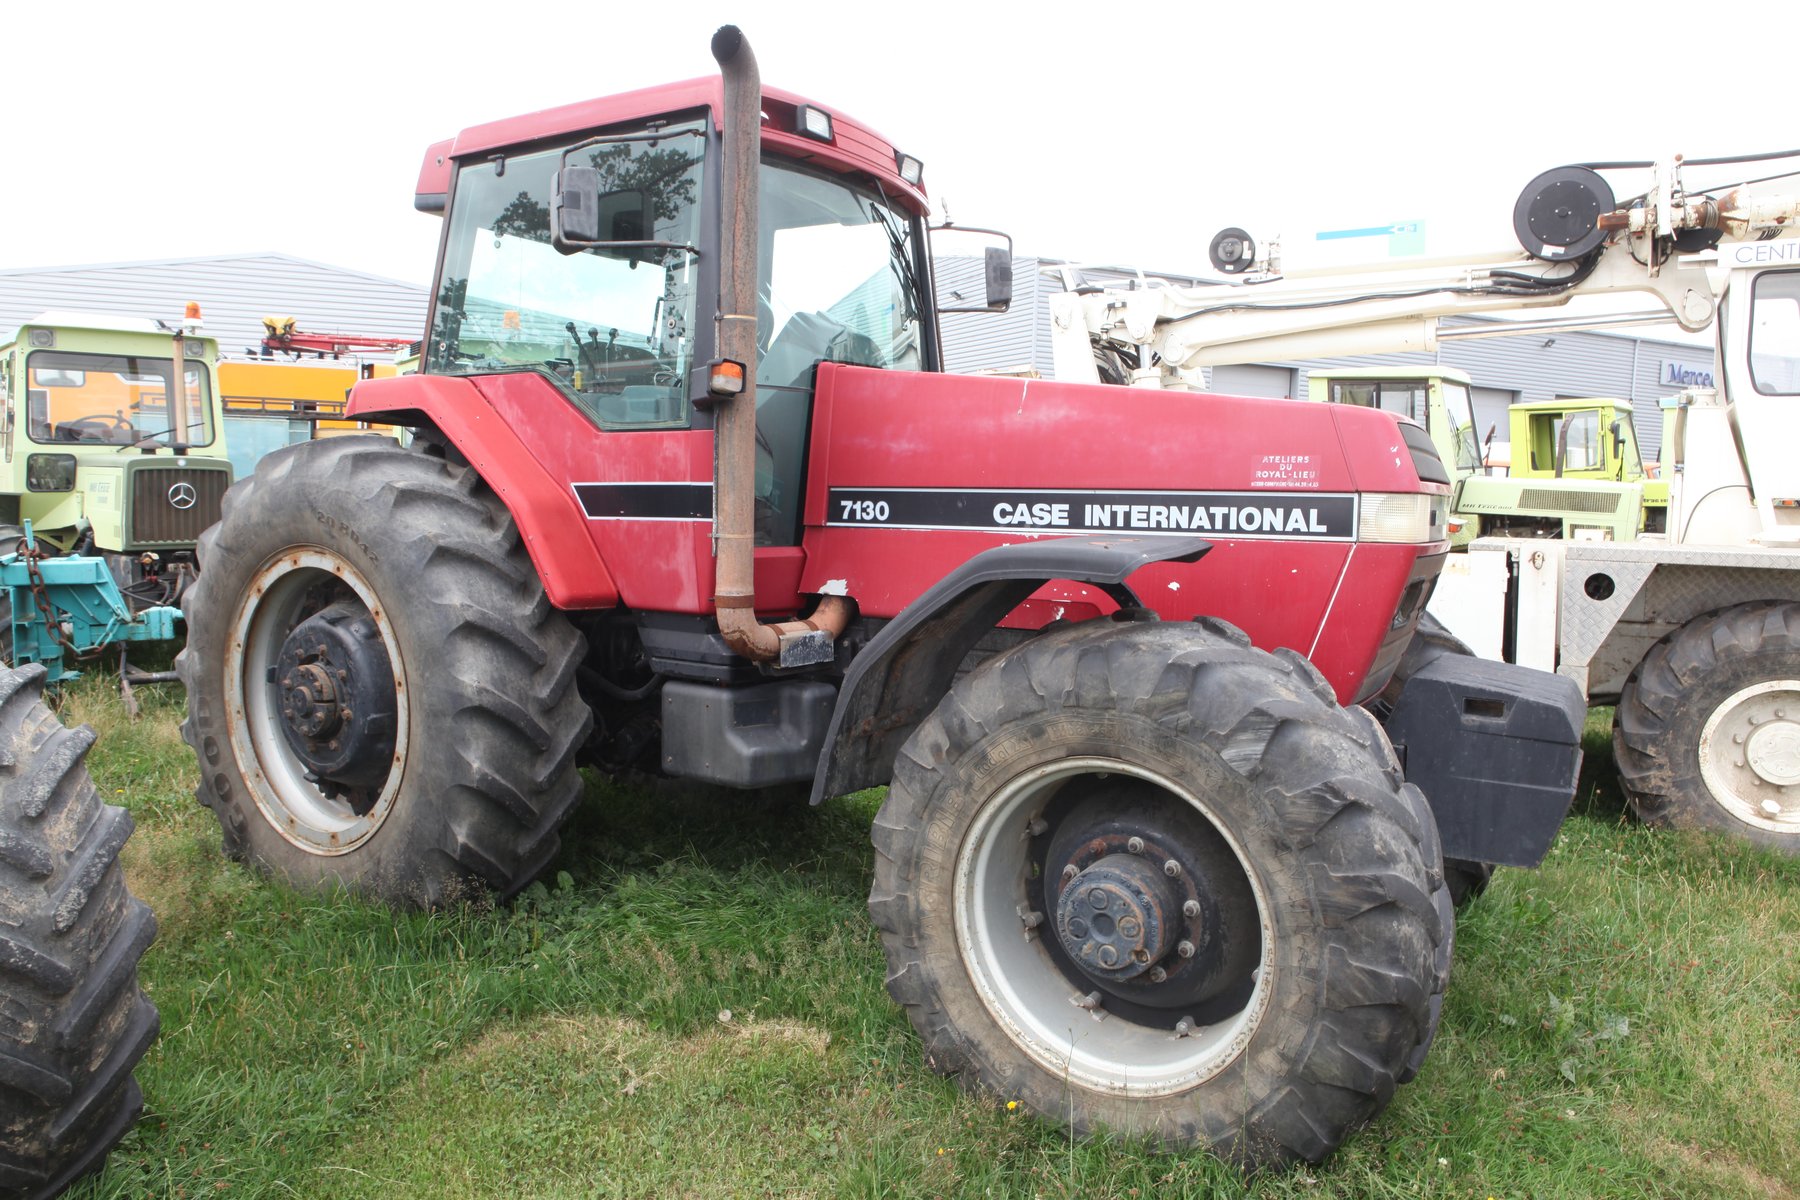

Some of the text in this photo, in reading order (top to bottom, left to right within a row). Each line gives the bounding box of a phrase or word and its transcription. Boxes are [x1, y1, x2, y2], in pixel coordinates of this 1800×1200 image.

[1736, 243, 1800, 263] CENT
[840, 500, 890, 521] 7130
[992, 503, 1328, 533] CASE INTERNATIONAL
[919, 787, 964, 934] AGRIBIB
